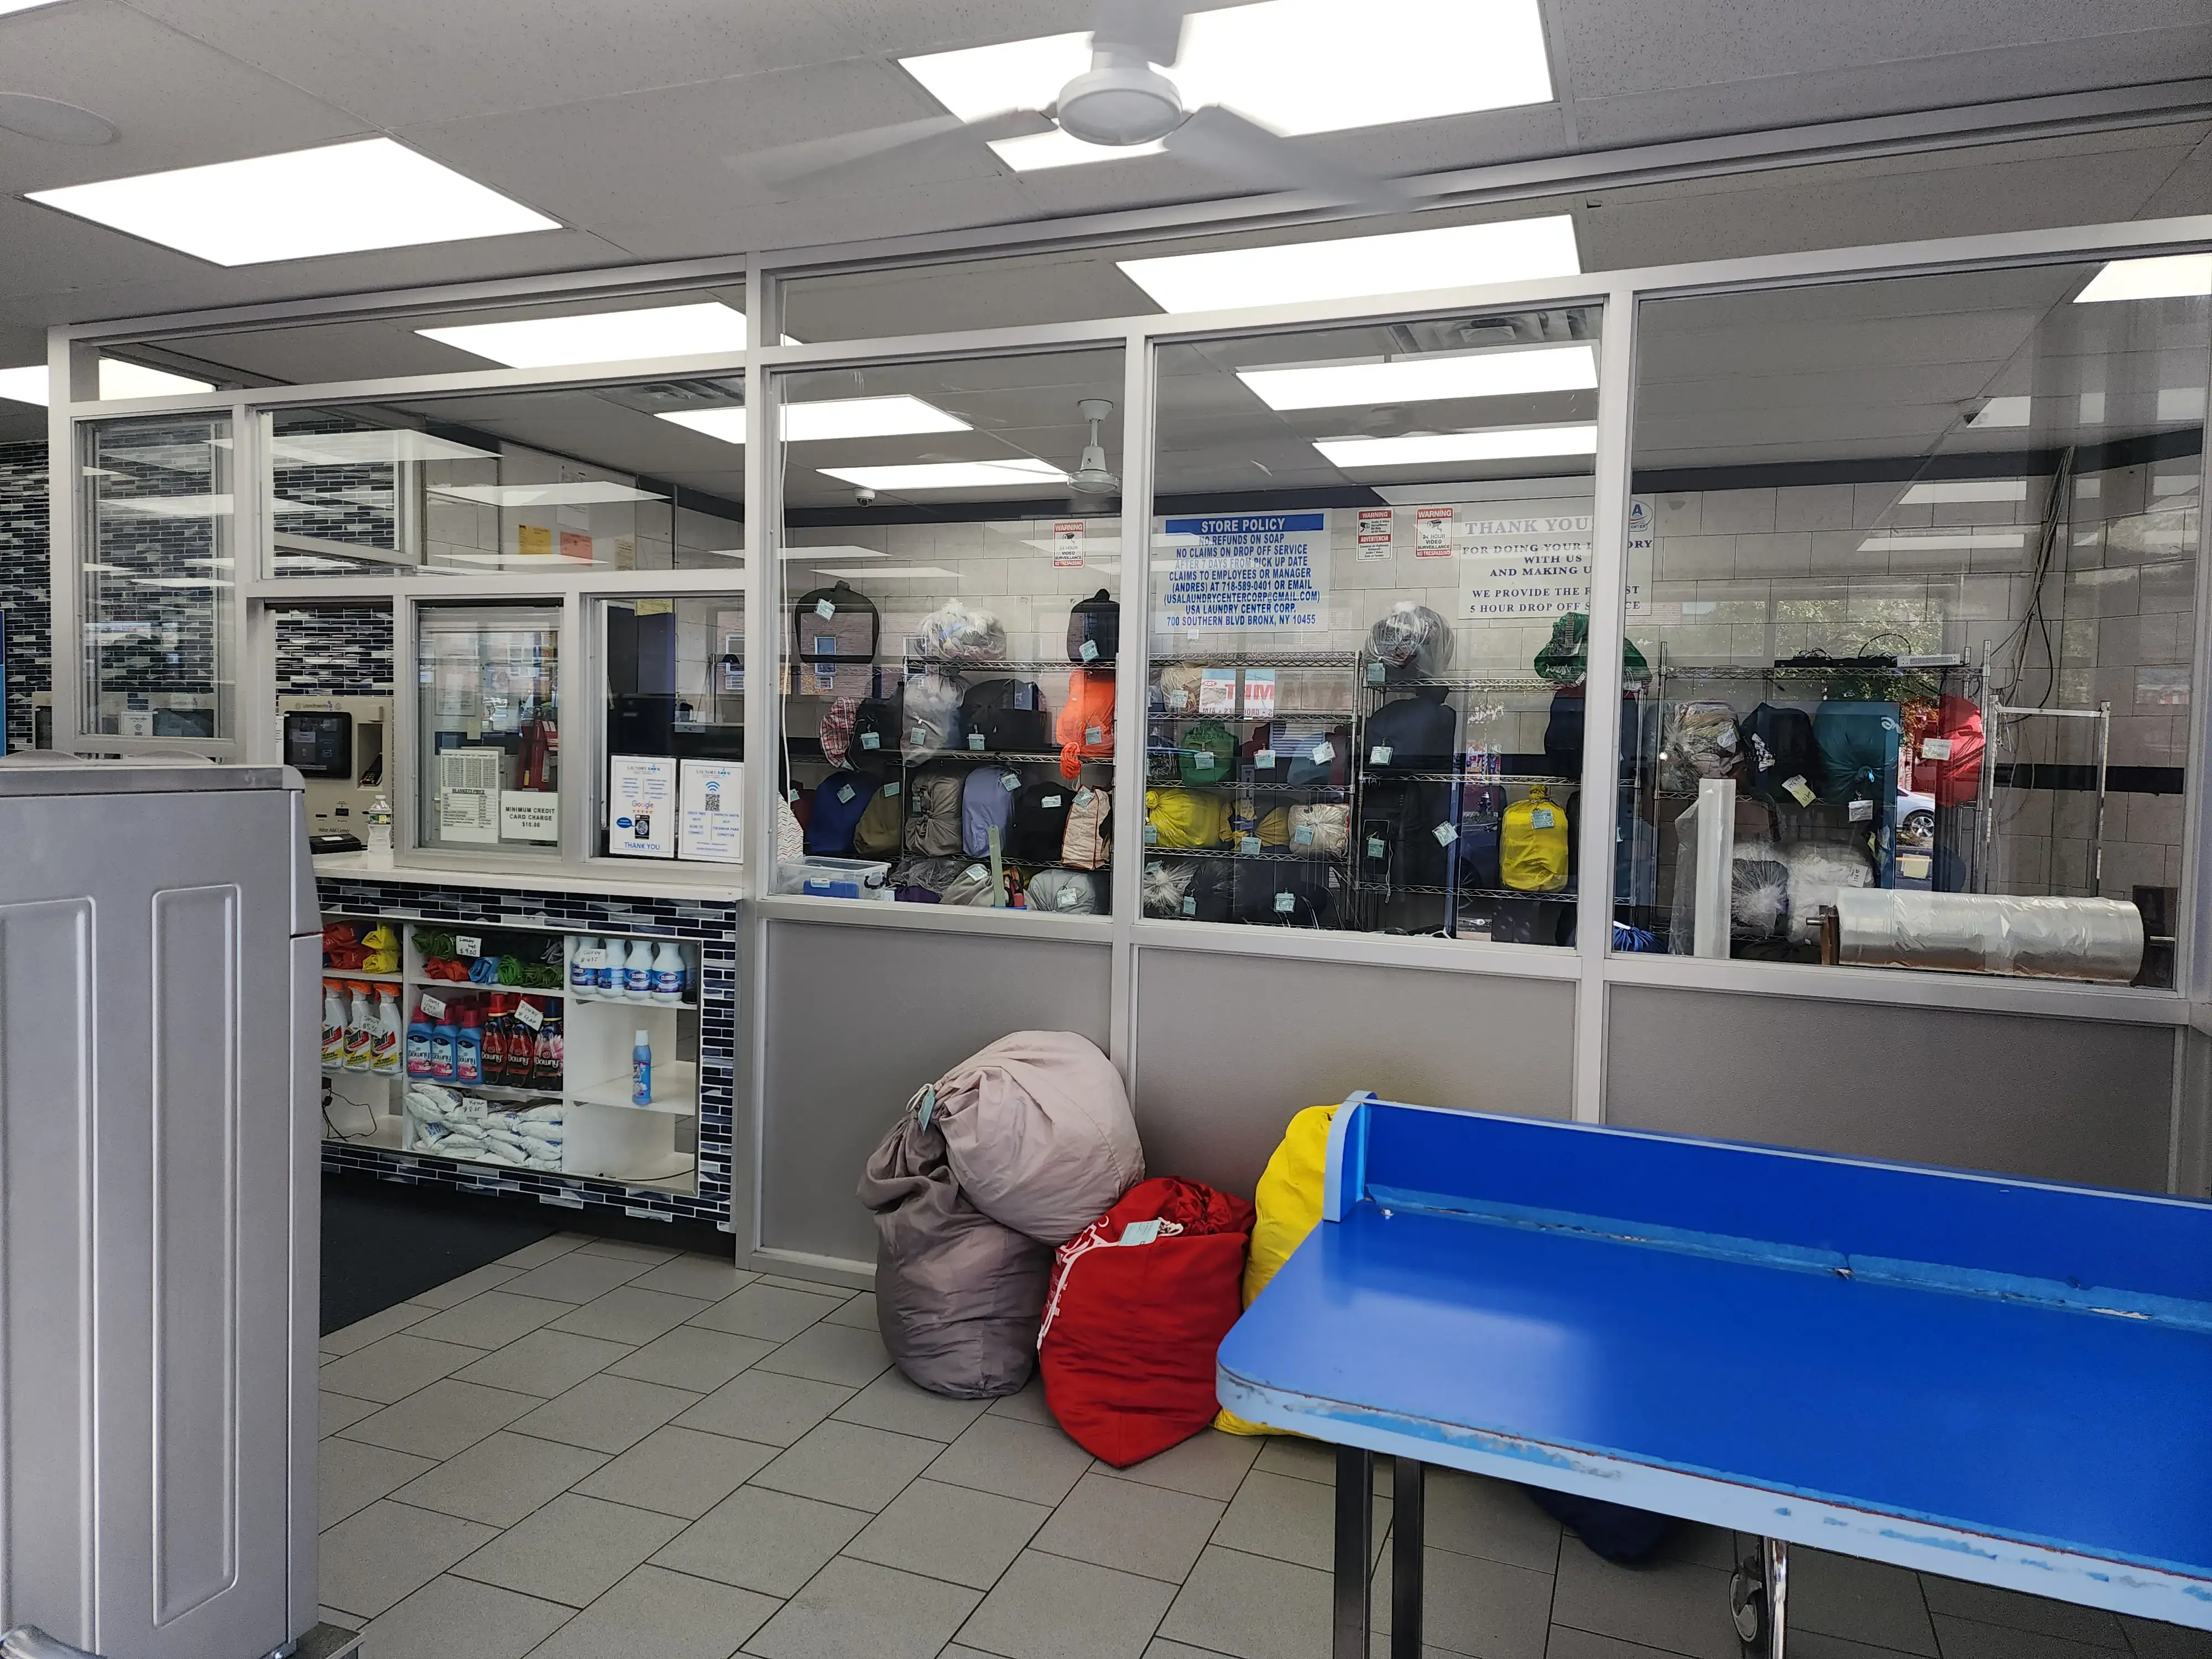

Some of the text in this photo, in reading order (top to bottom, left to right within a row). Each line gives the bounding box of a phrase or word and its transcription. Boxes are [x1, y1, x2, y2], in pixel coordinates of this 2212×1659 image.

[1201, 518, 1285, 533] STORE POLICY
[1465, 518, 1593, 534] THANK YOU
[1199, 533, 1285, 546] NO REFUNDS ON SOAP
[1176, 544, 1307, 559] NO CLAIMS ON DROP OFF SERVICE
[1494, 544, 1538, 553] DOING
[1543, 542, 1582, 551] YOUR
[1175, 556, 1307, 570] AFTER 7 DAYS FROM PICK UP DATE
[1169, 568, 1311, 581] CLAIMS TO EMPLOYEES OR MANAGER
[1490, 568, 1517, 577] AND
[1522, 566, 1578, 575] MAKING
[1172, 580, 1312, 593] (ANDRES) AT 718-589-0401 OR EMAIL
[1164, 591, 1321, 606] (USALAUNDRYCENTERCORP@GMAIL.COM)
[1473, 589, 1490, 598] WE
[1495, 588, 1550, 597] PROVIDE
[1186, 603, 1296, 615] USA LAUNDRY CENTER CORP.
[1480, 604, 1514, 613] HOUR
[1519, 603, 1552, 612] DROP
[1167, 614, 1316, 627] 700 SOUTHERN BLVD BRONX, NY 10455
[632, 800, 654, 809] Google
[408, 1050, 430, 1059] Downy
[433, 1052, 451, 1062] Downy
[458, 1056, 475, 1065] Downy
[482, 1051, 503, 1062] Downy
[508, 1054, 530, 1066] Downy
[535, 1057, 560, 1068] Downy
